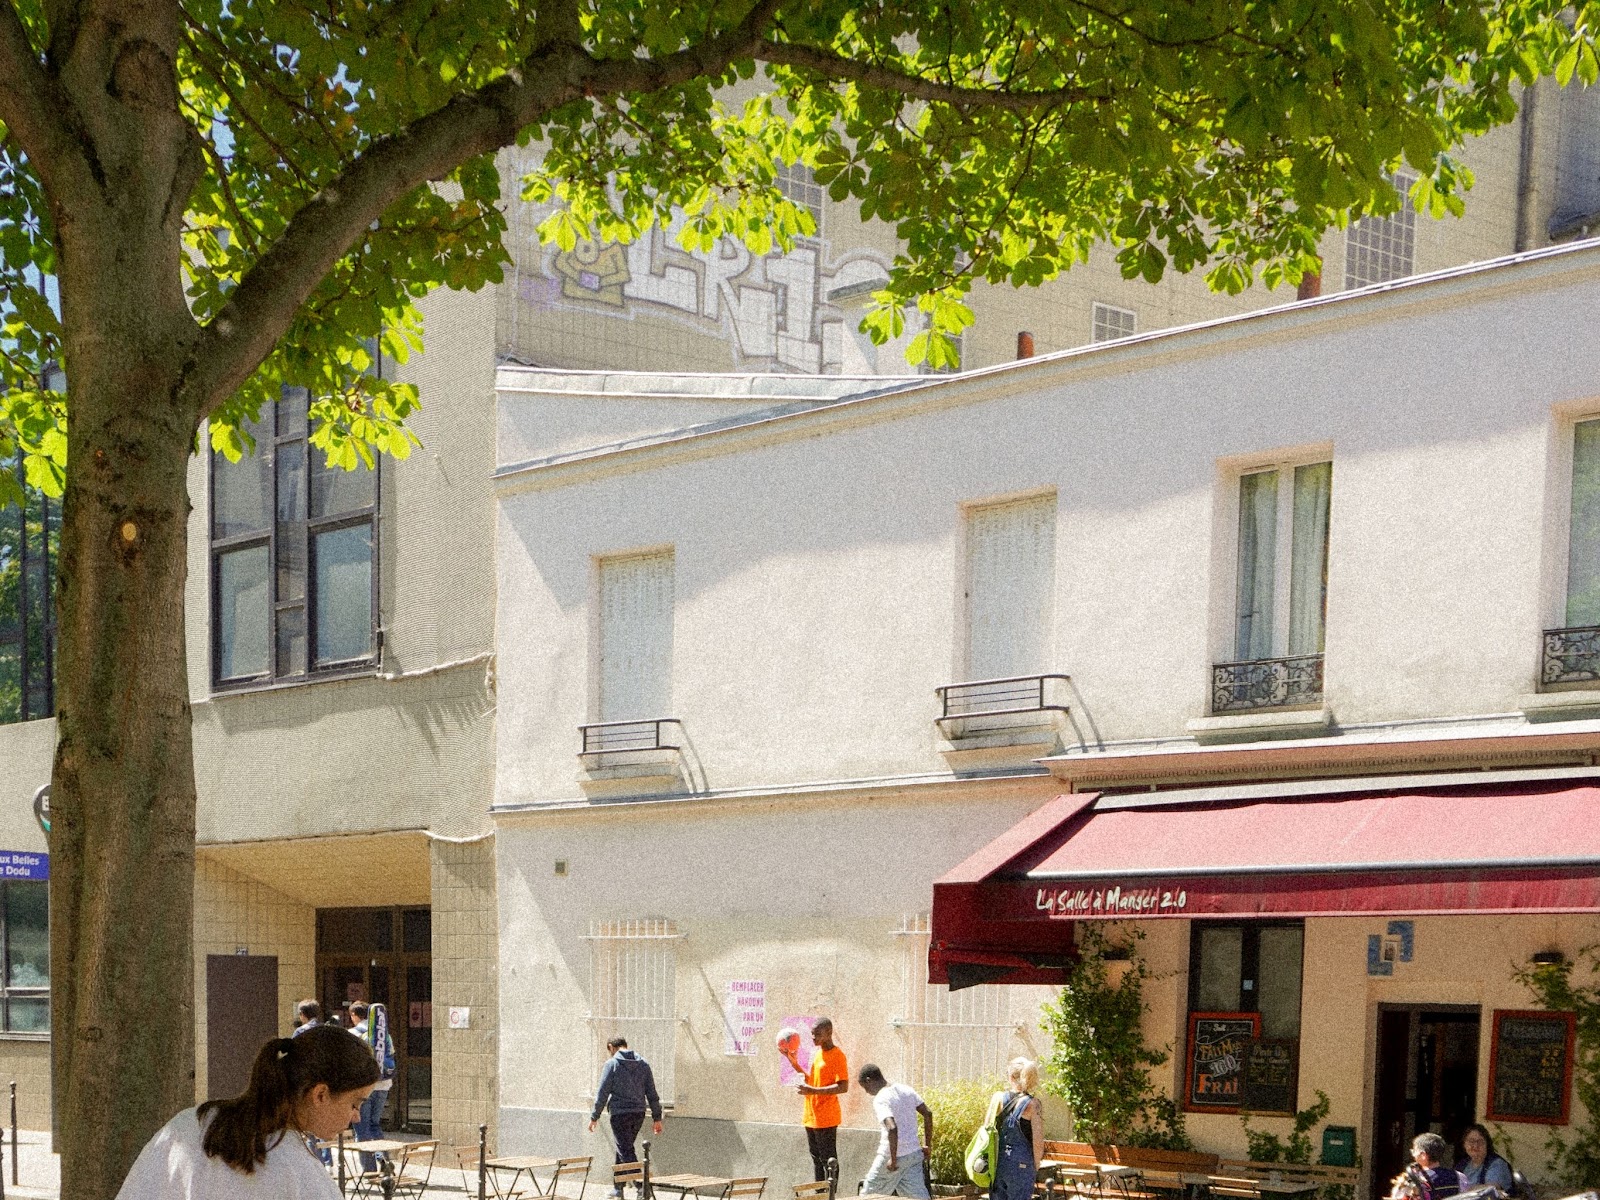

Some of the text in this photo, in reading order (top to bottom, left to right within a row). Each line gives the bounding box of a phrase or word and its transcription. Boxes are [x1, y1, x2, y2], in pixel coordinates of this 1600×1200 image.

[12, 855, 39, 866] Belles
[6, 865, 30, 876] Dodu
[1036, 886, 1186, 912] La Salle à Manger 2.0
[731, 981, 764, 993] REMPLACER
[742, 1012, 754, 1022] PAR
